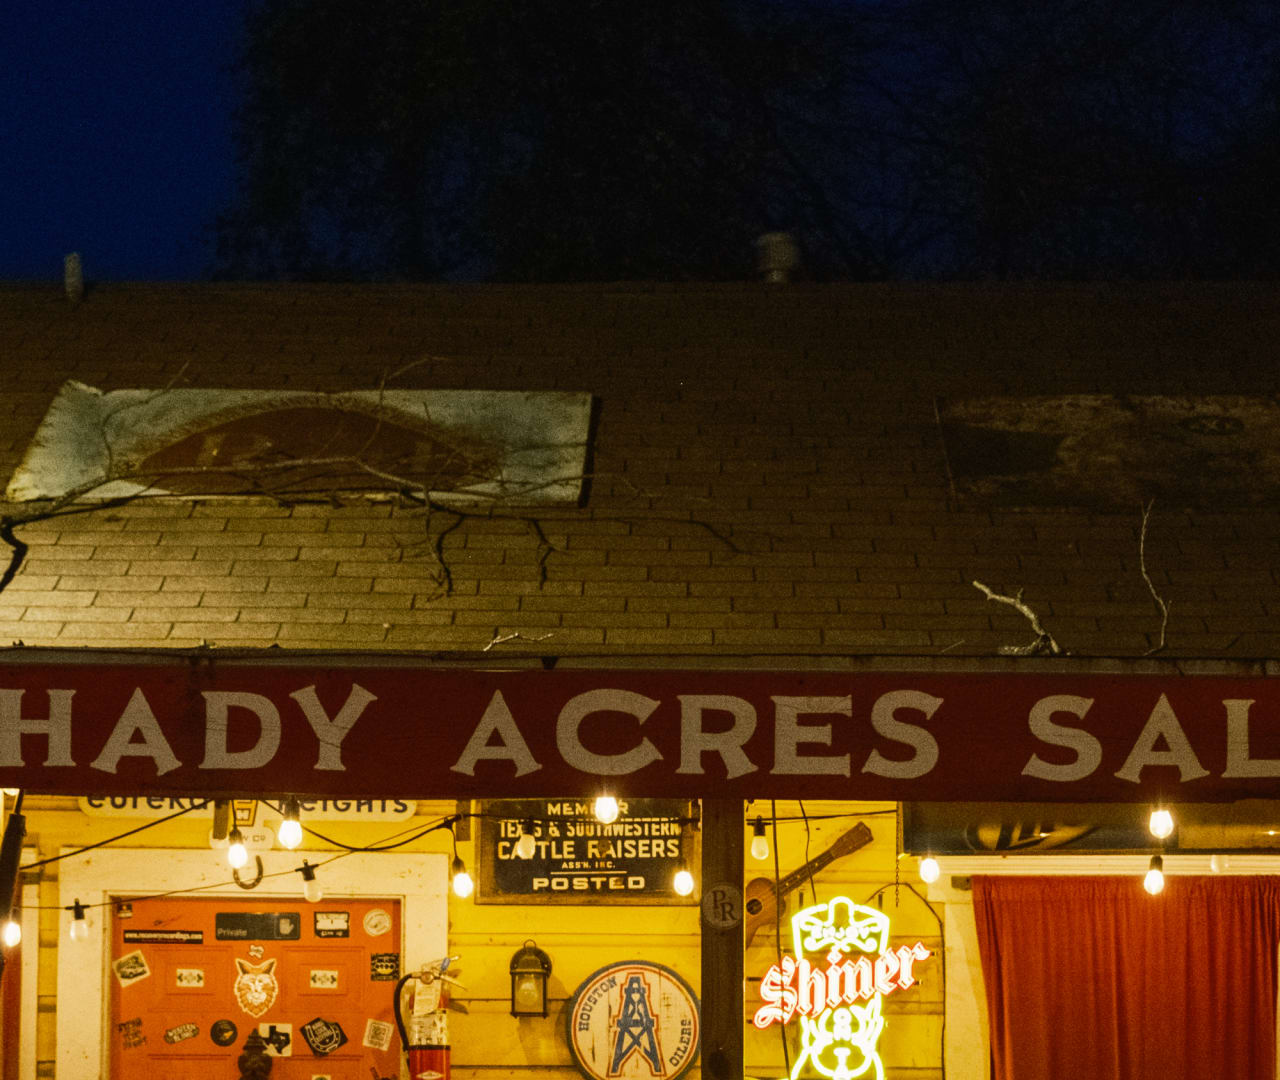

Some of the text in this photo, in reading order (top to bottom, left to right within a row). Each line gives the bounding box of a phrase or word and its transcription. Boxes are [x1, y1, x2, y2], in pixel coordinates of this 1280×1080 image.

[450, 688, 944, 779] ACRES
[498, 818, 542, 838] TEXS
[497, 838, 680, 860] CATLE RAISERS
[532, 876, 646, 890] POSTED
[216, 928, 248, 938] Private
[753, 941, 931, 1030] Shiner
[578, 975, 618, 1033] HOUSTON
[668, 1018, 692, 1068] OILERS
